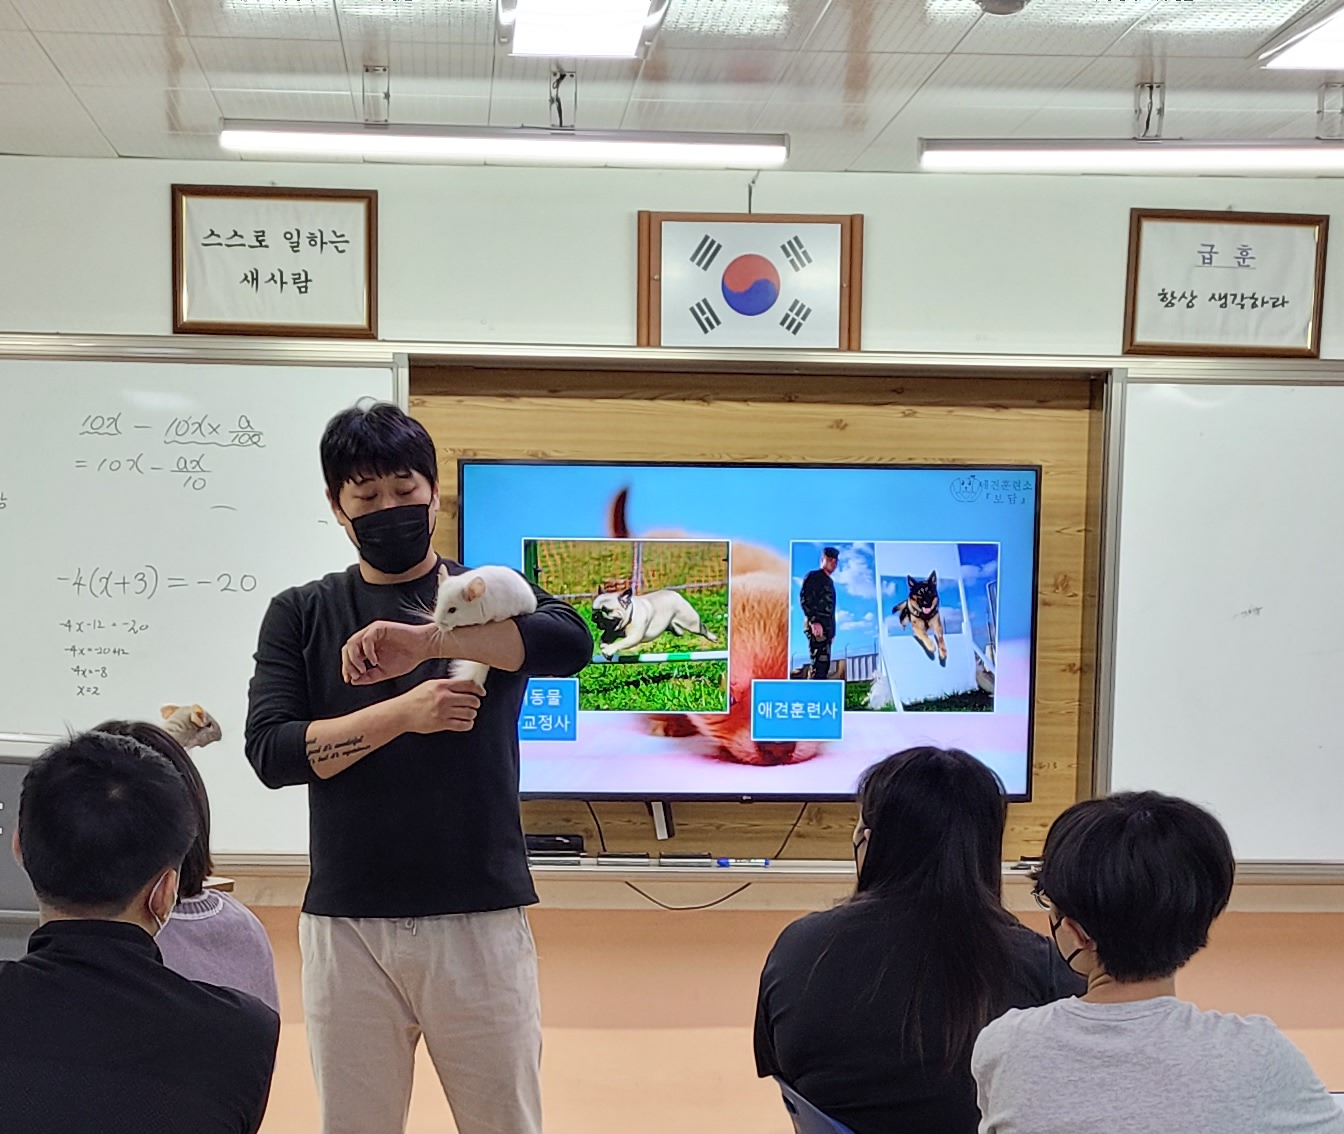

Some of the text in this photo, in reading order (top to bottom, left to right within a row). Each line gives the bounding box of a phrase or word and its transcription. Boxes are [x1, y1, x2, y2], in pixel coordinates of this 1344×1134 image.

[201, 228, 350, 254] 스스로 일하는
[1197, 243, 1256, 267] 급 훈
[239, 267, 313, 294] 새사람
[1157, 288, 1290, 309] 항상 생각하라
[524, 688, 563, 707] 동물
[757, 702, 838, 720] 애견훈련사
